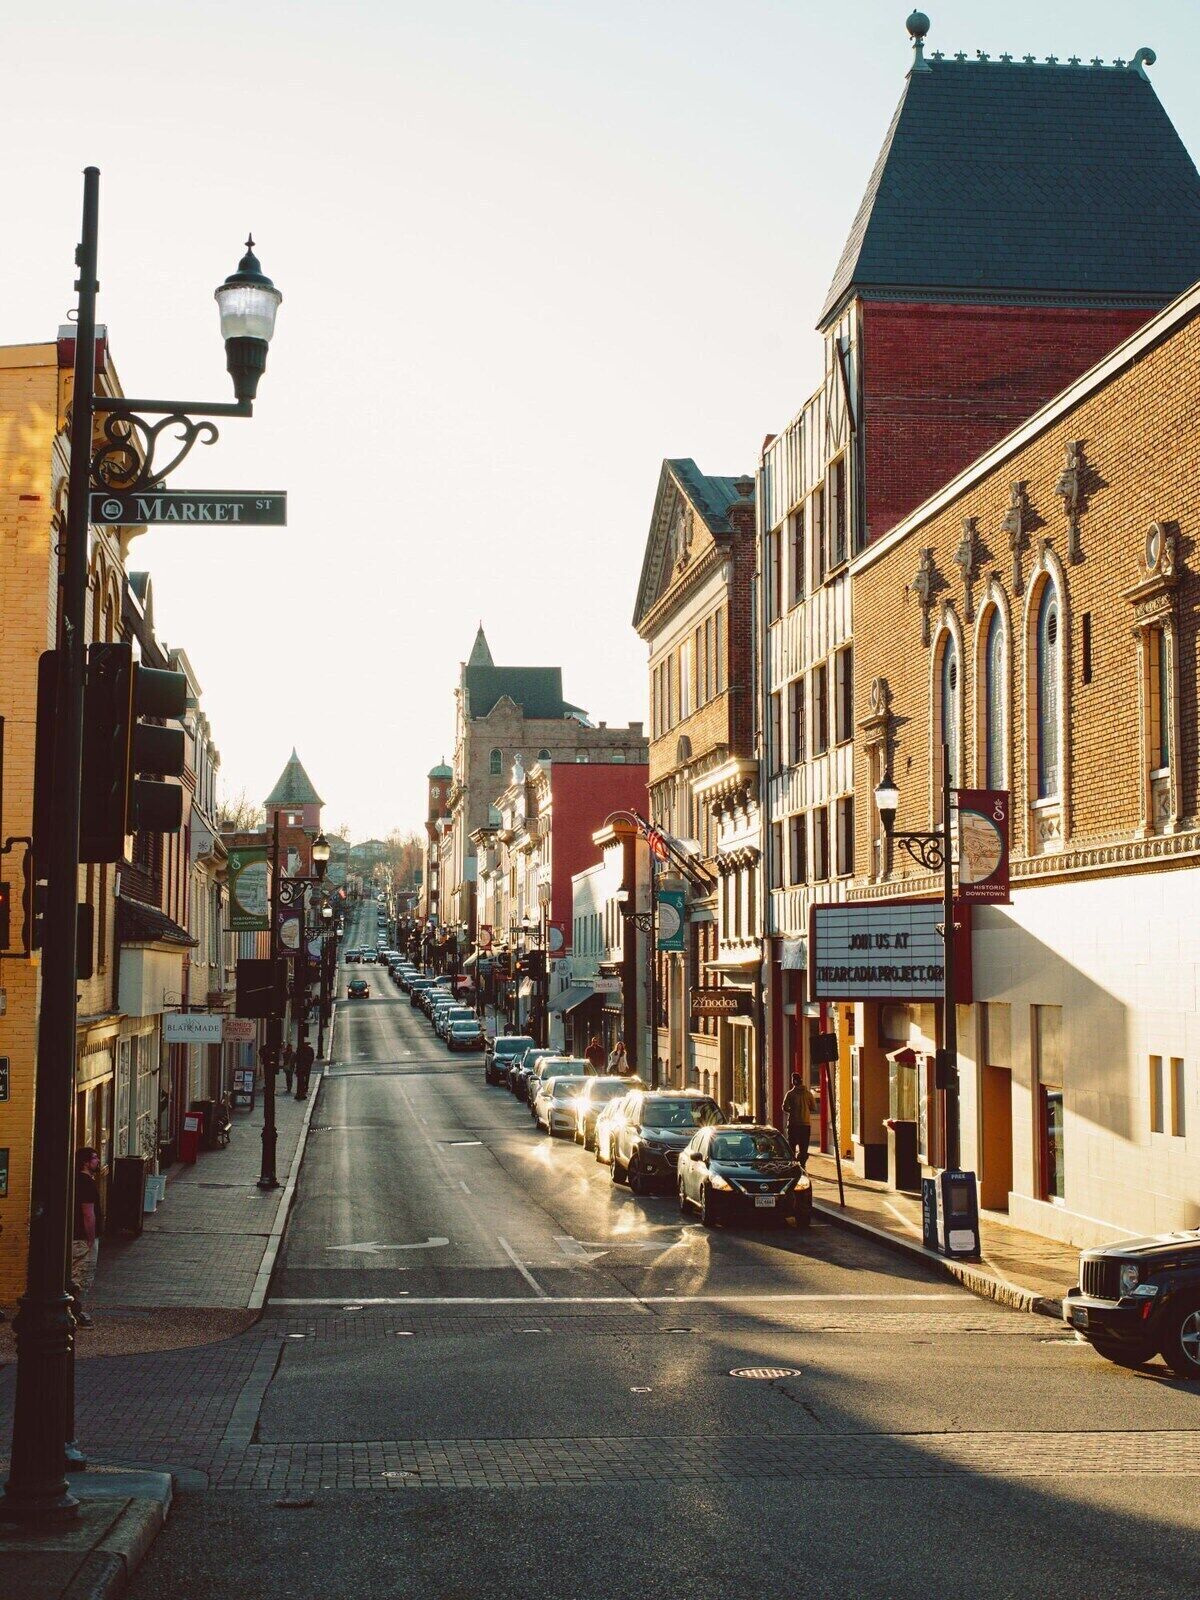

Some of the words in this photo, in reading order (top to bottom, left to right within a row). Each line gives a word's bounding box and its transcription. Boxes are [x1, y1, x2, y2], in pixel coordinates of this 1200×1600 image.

[255, 500, 272, 509] ST
[848, 934, 872, 950] JOIN
[875, 933, 890, 950] US
[894, 932, 910, 949] AT
